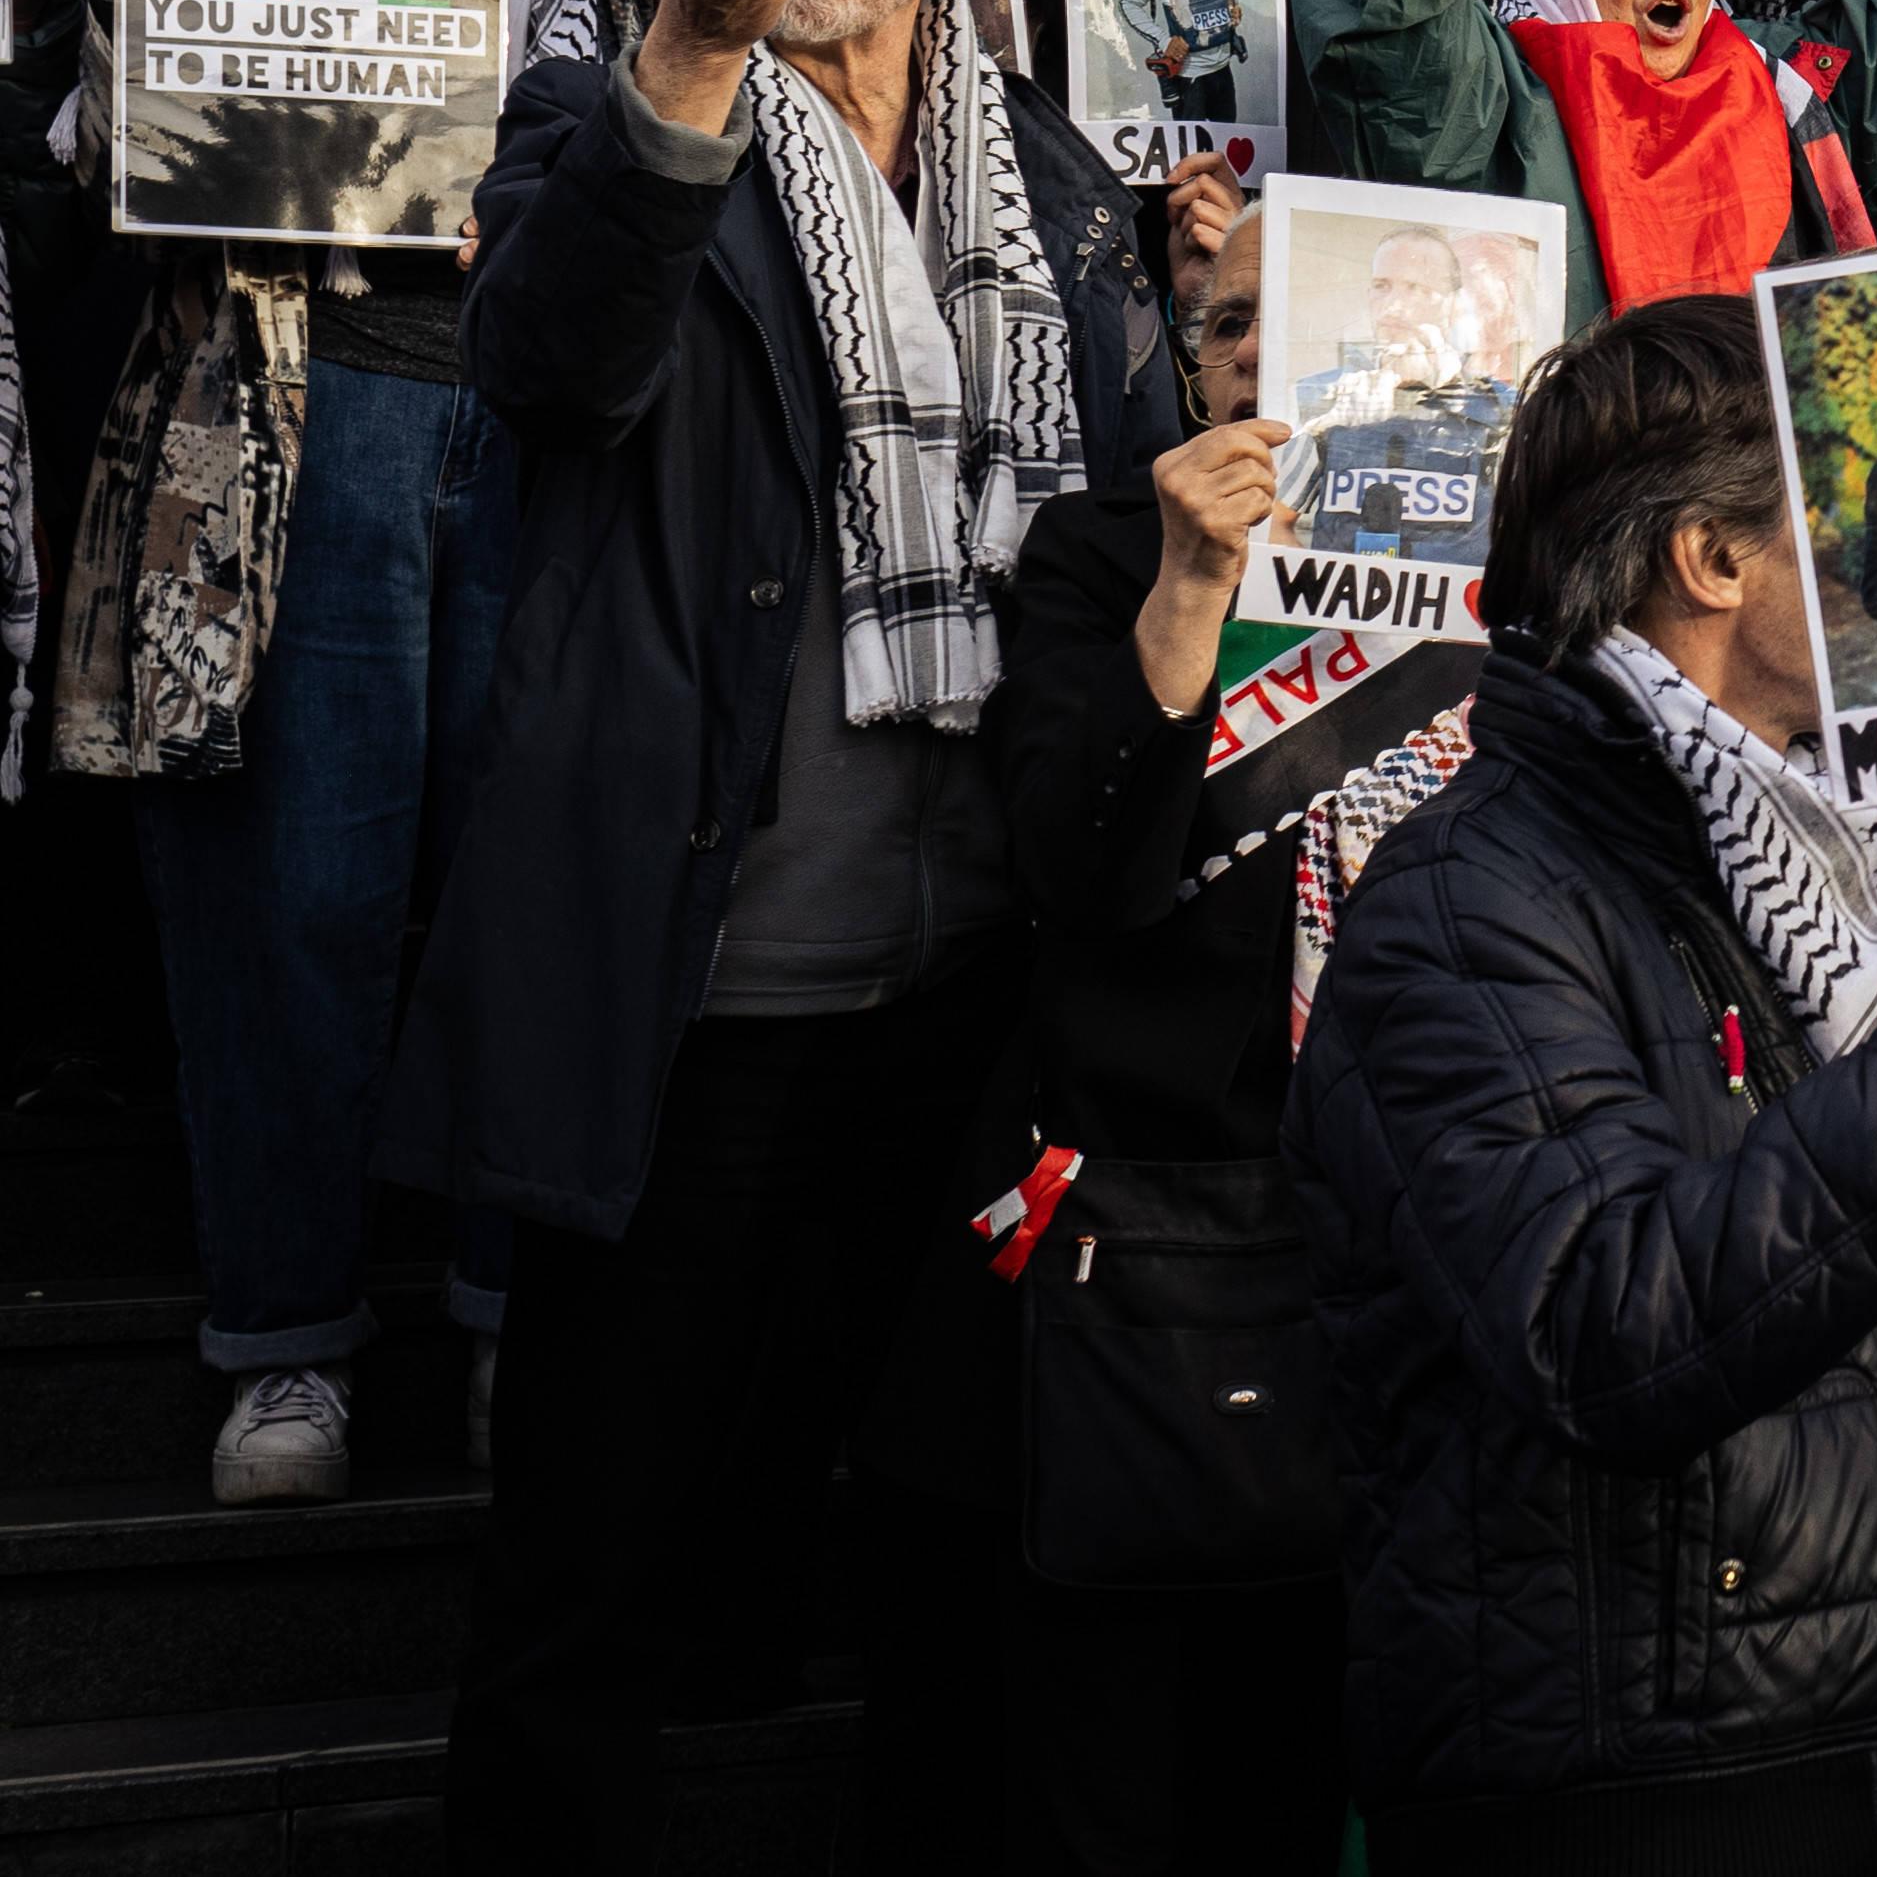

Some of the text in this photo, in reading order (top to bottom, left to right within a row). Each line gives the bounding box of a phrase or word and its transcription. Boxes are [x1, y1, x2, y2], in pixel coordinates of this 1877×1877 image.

[253, 4, 360, 42] JUST
[378, 11, 483, 49] NEED
[1194, 9, 1228, 30] PRESS
[148, 50, 443, 99] TO BE HUMAN
[1272, 556, 1447, 630] WADIH
